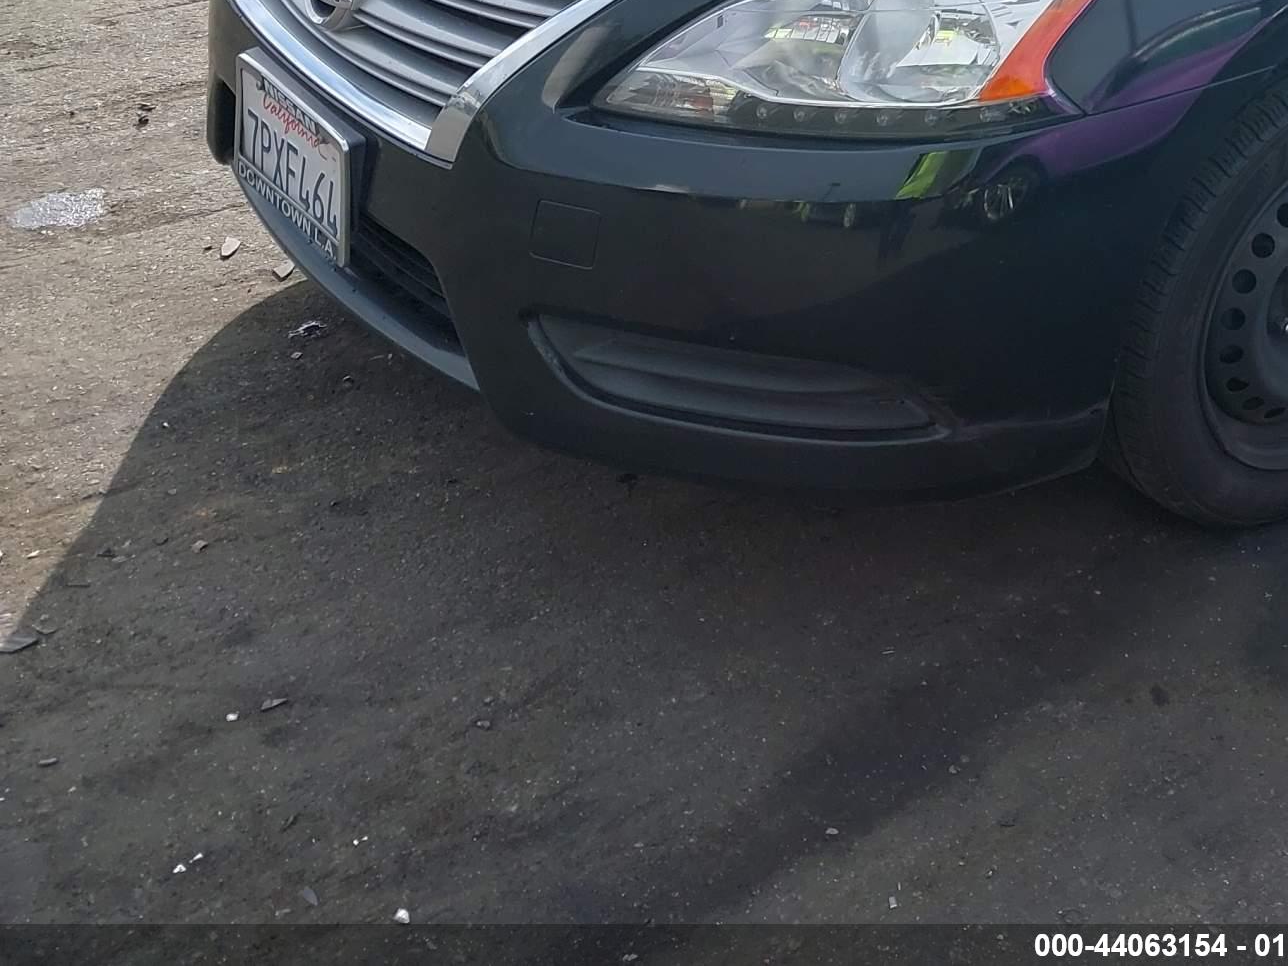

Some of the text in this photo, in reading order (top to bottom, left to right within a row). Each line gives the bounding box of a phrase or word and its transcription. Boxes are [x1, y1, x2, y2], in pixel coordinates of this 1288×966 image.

[263, 78, 319, 136] NISSAN
[238, 160, 337, 261] DOWNTOWN L.A.
[247, 108, 338, 240] 7PXF464
